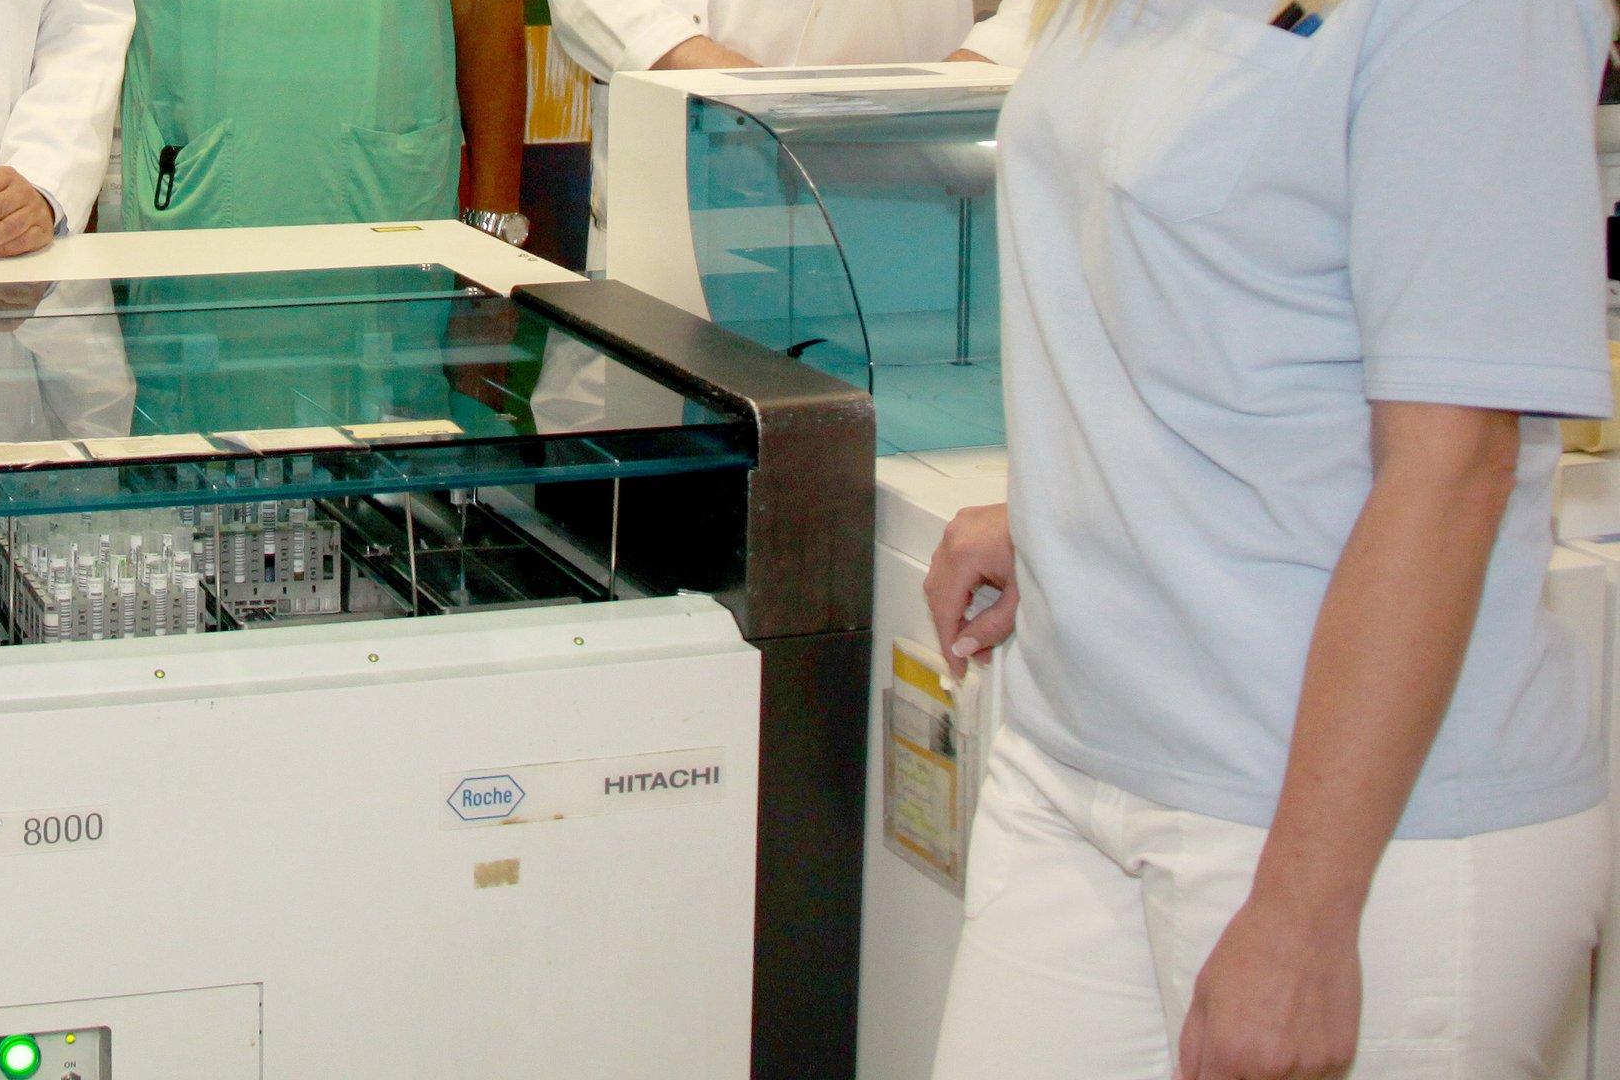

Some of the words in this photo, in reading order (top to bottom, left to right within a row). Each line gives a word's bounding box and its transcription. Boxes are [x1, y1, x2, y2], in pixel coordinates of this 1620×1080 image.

[603, 766, 720, 795] HITACHI
[461, 786, 513, 808] Roche
[22, 812, 104, 847] 8000
